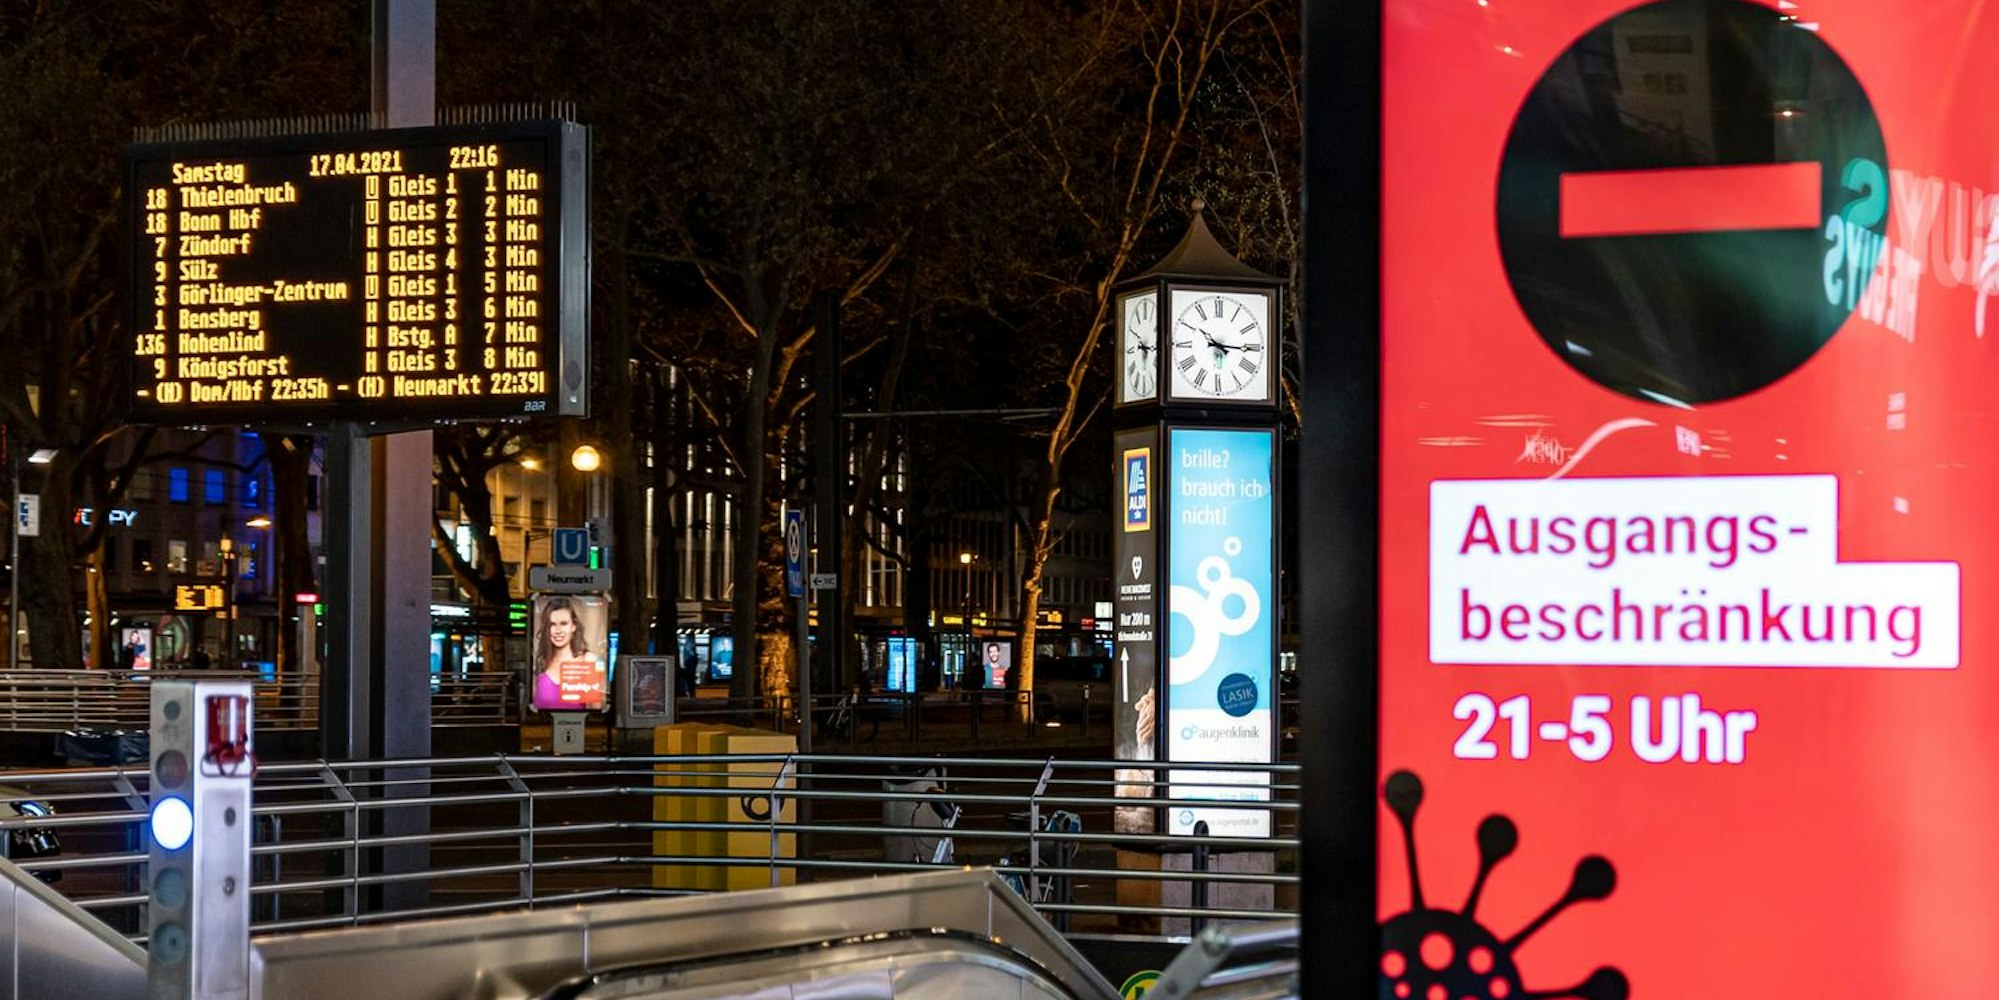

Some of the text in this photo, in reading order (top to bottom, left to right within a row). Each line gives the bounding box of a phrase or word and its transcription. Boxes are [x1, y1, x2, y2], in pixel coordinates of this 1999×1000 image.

[172, 145, 498, 184] Samstag 17.04.2021 22:16
[146, 188, 167, 210] 18
[180, 182, 296, 208] Thielenbruch
[388, 174, 436, 197] Gleis
[446, 172, 458, 194] 1
[485, 170, 496, 192] 1
[506, 168, 538, 191] Min
[146, 212, 167, 234] 18
[180, 211, 221, 232] Bonn
[229, 208, 261, 230] Hbf
[388, 199, 436, 222] Gleis
[446, 198, 457, 219] 2
[485, 195, 496, 217] 2
[506, 194, 538, 216] Min
[155, 219, 538, 258] 7 Zündorf H Gleis 3 3 Min
[155, 245, 537, 282] 9 Sülz H Gleis 4 3 Min
[155, 285, 166, 306] 3
[179, 280, 347, 306] Görlinger-Zentrum
[388, 274, 436, 297] Gleis
[445, 273, 457, 294] 1
[484, 271, 496, 293] 5
[506, 270, 537, 292] Min
[154, 295, 537, 330] 1 Bensberg H Gleis 3 6 Min
[135, 321, 537, 355] 136 Hohenlind H Bstg. A 7 Min
[154, 346, 537, 380] 9 Königsforst H Gleis 3 8 Min
[190, 379, 263, 402] Dom/Hbf
[271, 377, 328, 400] 22:35h
[394, 374, 481, 397] Neumarkt
[1181, 448, 1230, 469] brille?
[1128, 495, 1146, 511] ALDI
[1181, 476, 1263, 498] brauch ich
[80, 507, 138, 527] CPY
[1181, 505, 1227, 526] nicht!
[562, 533, 583, 560] U
[1458, 504, 1809, 569] Ausgangs-
[547, 574, 594, 584] Neumarkt
[1459, 587, 1923, 657] beschränkung
[1222, 687, 1254, 704] LASIK
[1198, 726, 1260, 742] augenklinik
[1452, 692, 1757, 763] 21-5 Uhr
